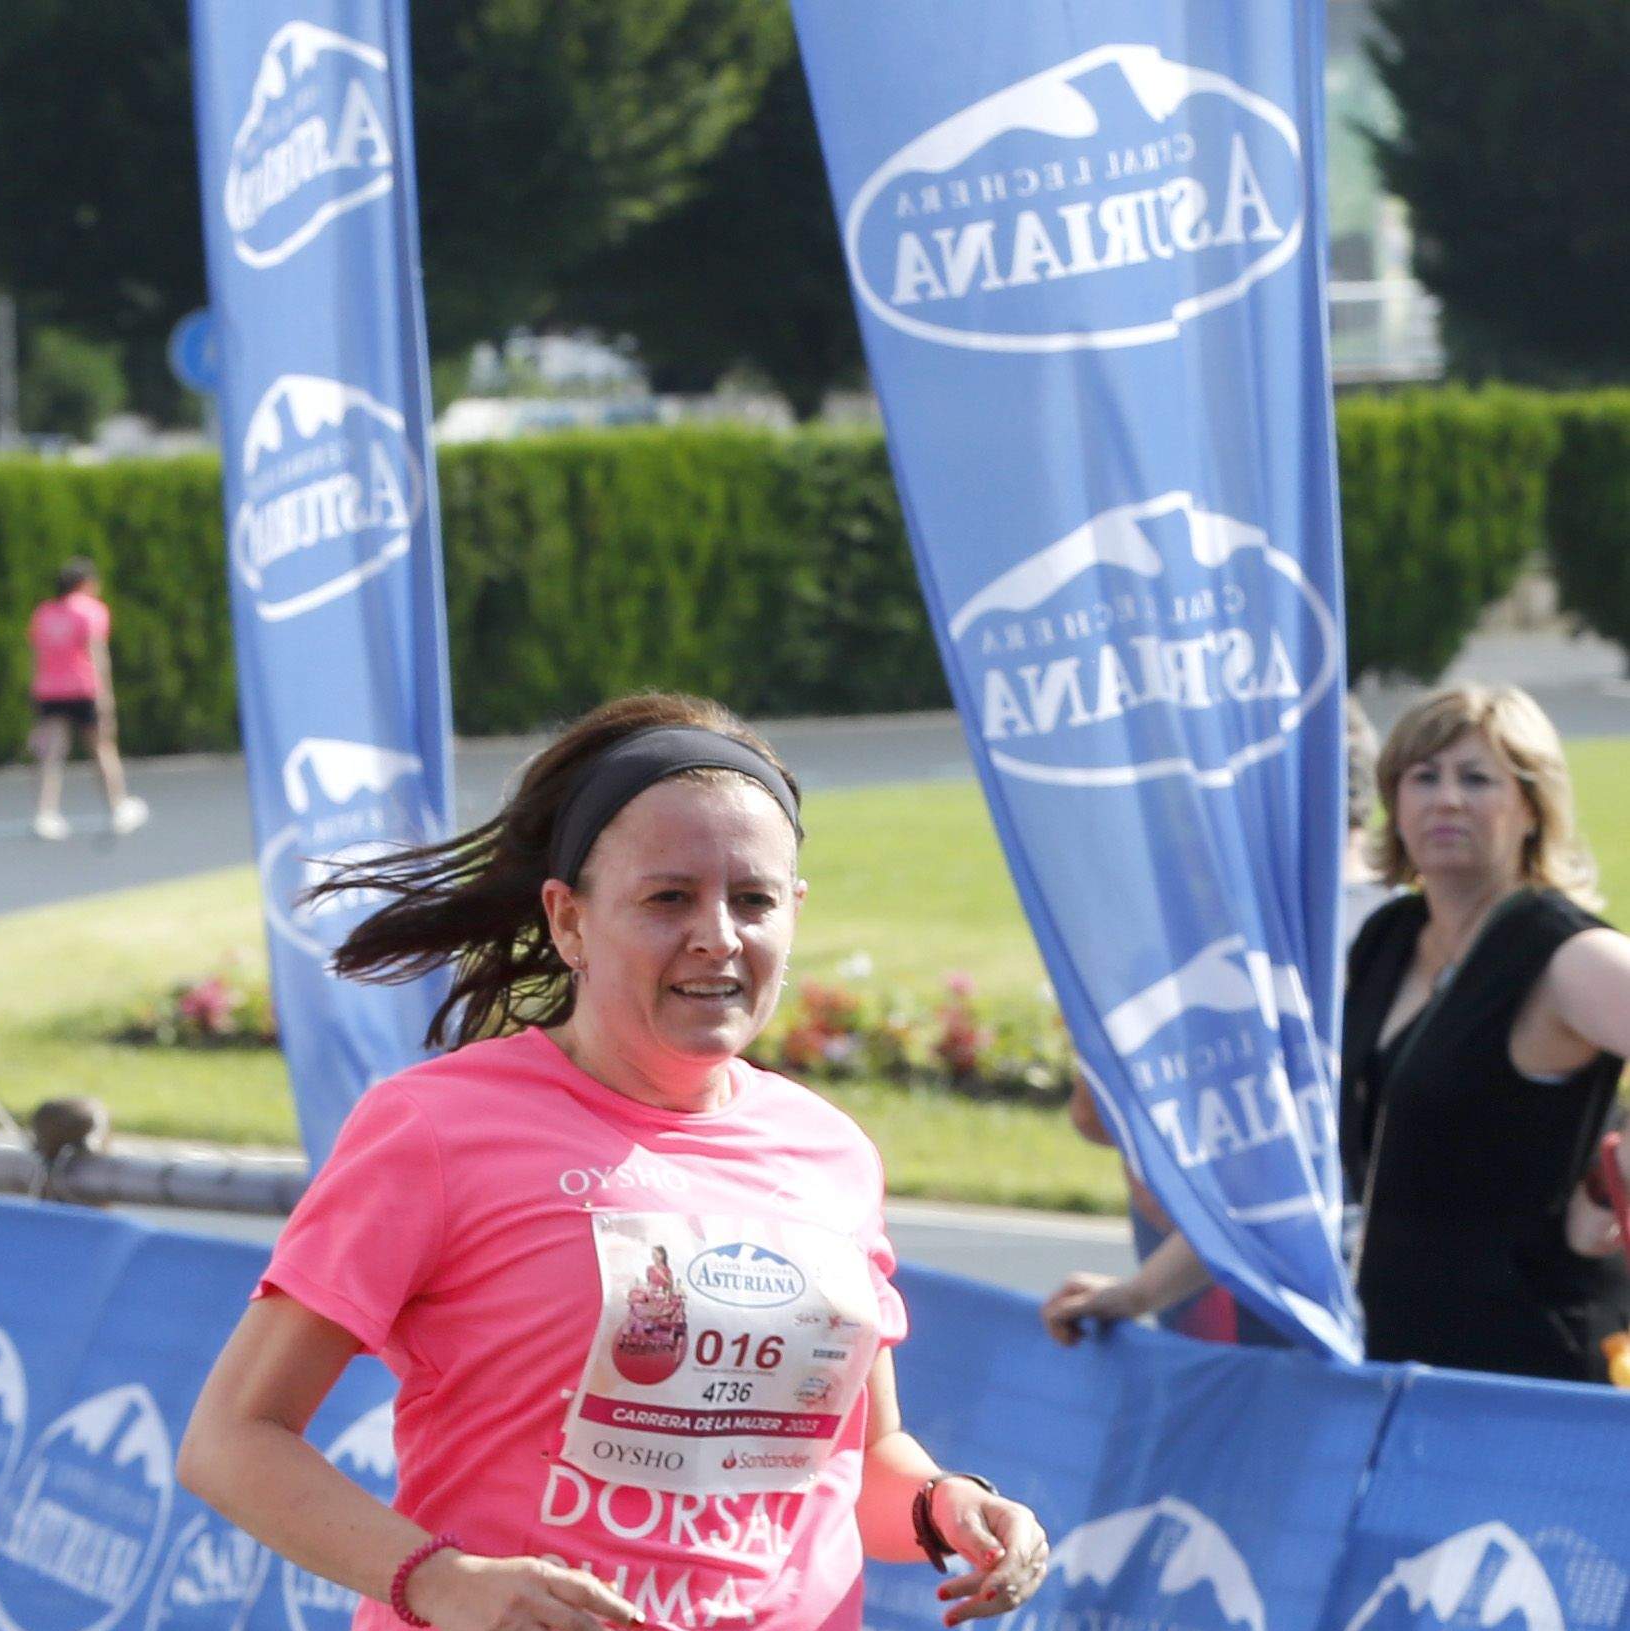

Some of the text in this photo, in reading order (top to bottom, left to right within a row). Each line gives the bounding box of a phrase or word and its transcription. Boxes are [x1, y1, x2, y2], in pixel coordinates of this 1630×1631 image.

[559, 1165, 687, 1196] OYSHO
[696, 1262, 797, 1294] ASTURIANA
[695, 1329, 786, 1370] 016
[702, 1381, 753, 1403] 4736
[612, 1407, 690, 1430] CARRERA
[694, 1416, 714, 1432] DE
[714, 1417, 733, 1432] LA
[733, 1416, 782, 1432] MUJER
[593, 1440, 685, 1471] OYSHO
[739, 1451, 811, 1469] Santander
[540, 1463, 793, 1555] DORSAL
